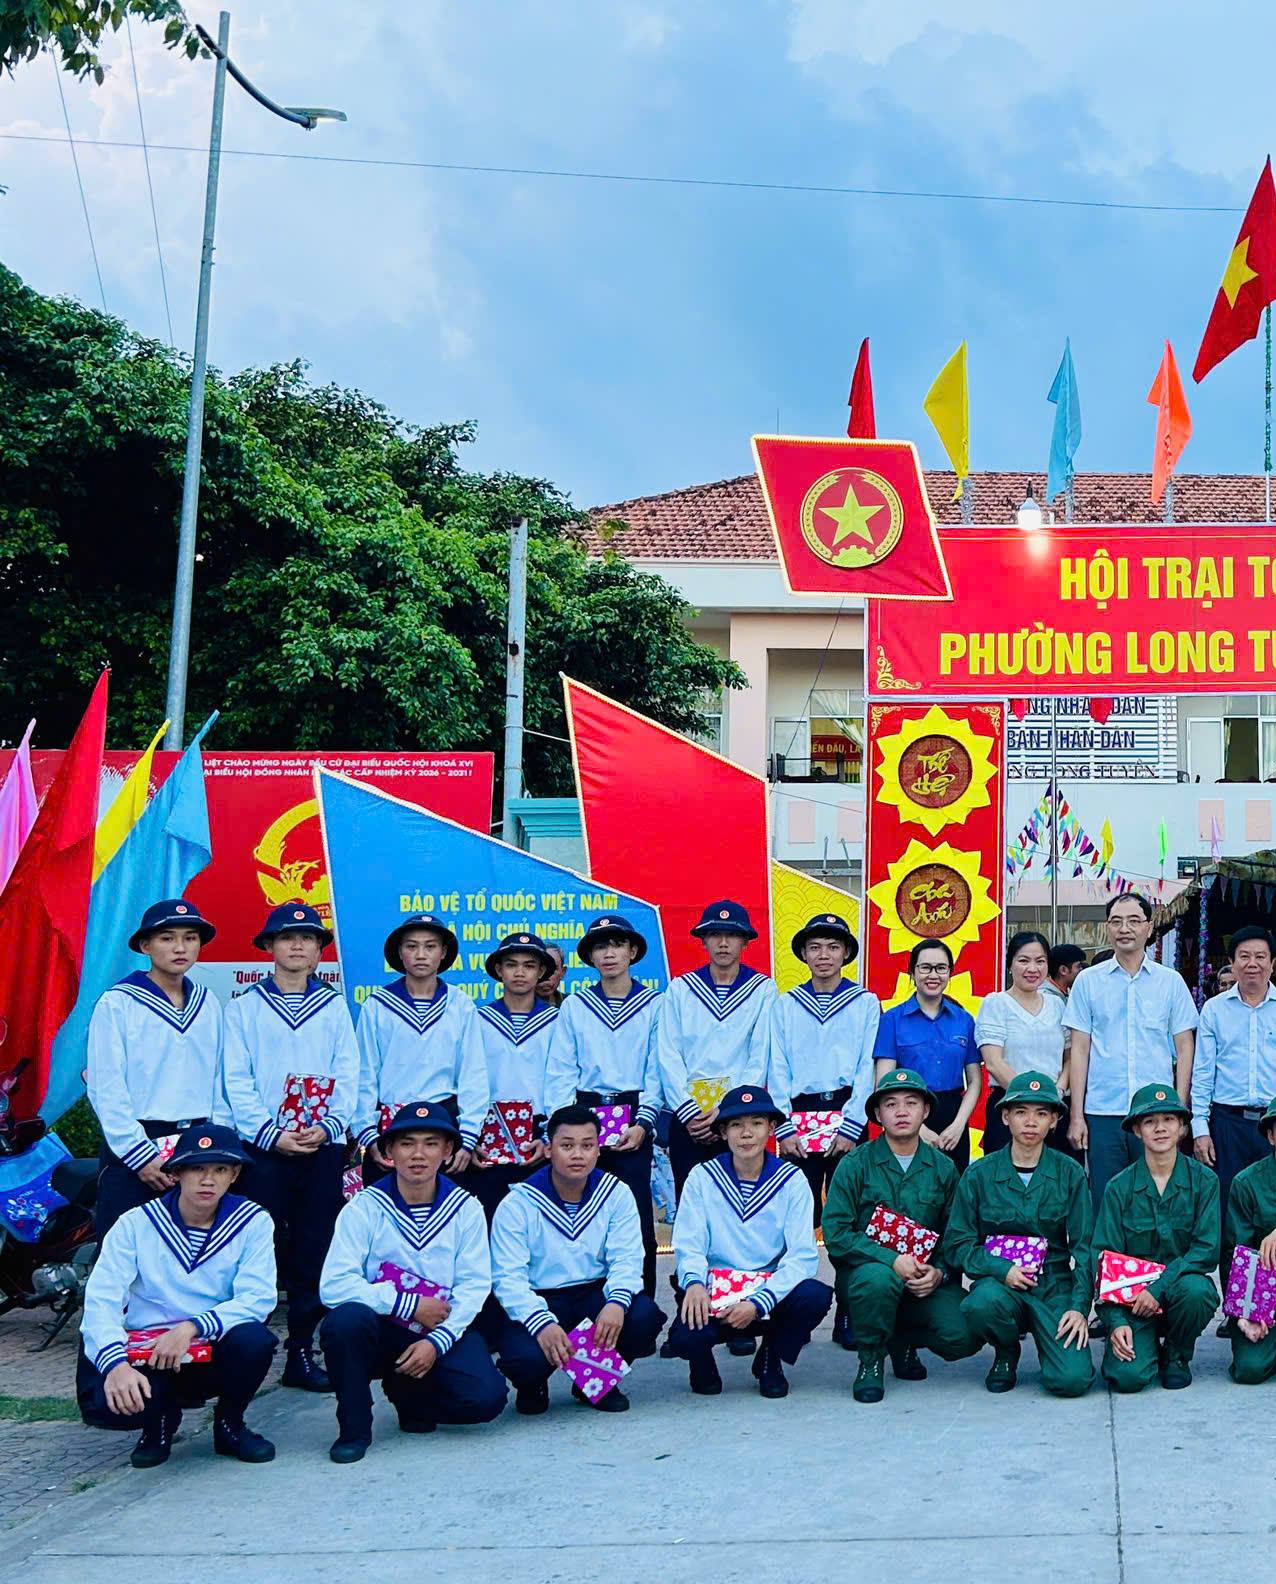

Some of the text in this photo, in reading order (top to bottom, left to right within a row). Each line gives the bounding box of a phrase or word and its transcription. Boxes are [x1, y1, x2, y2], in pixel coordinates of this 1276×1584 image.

[1060, 548, 1128, 609] HỘI
[1142, 557, 1234, 608] TRẠI
[940, 621, 1112, 675] PHƯỜNG
[1127, 631, 1235, 674] LONG
[224, 758, 251, 767] CHÀO
[400, 888, 618, 915] BẢO VỆ TỔ QUỐC VIỆT NAM
[463, 919, 491, 945] HỘI
[534, 919, 585, 940] NGHĨA
